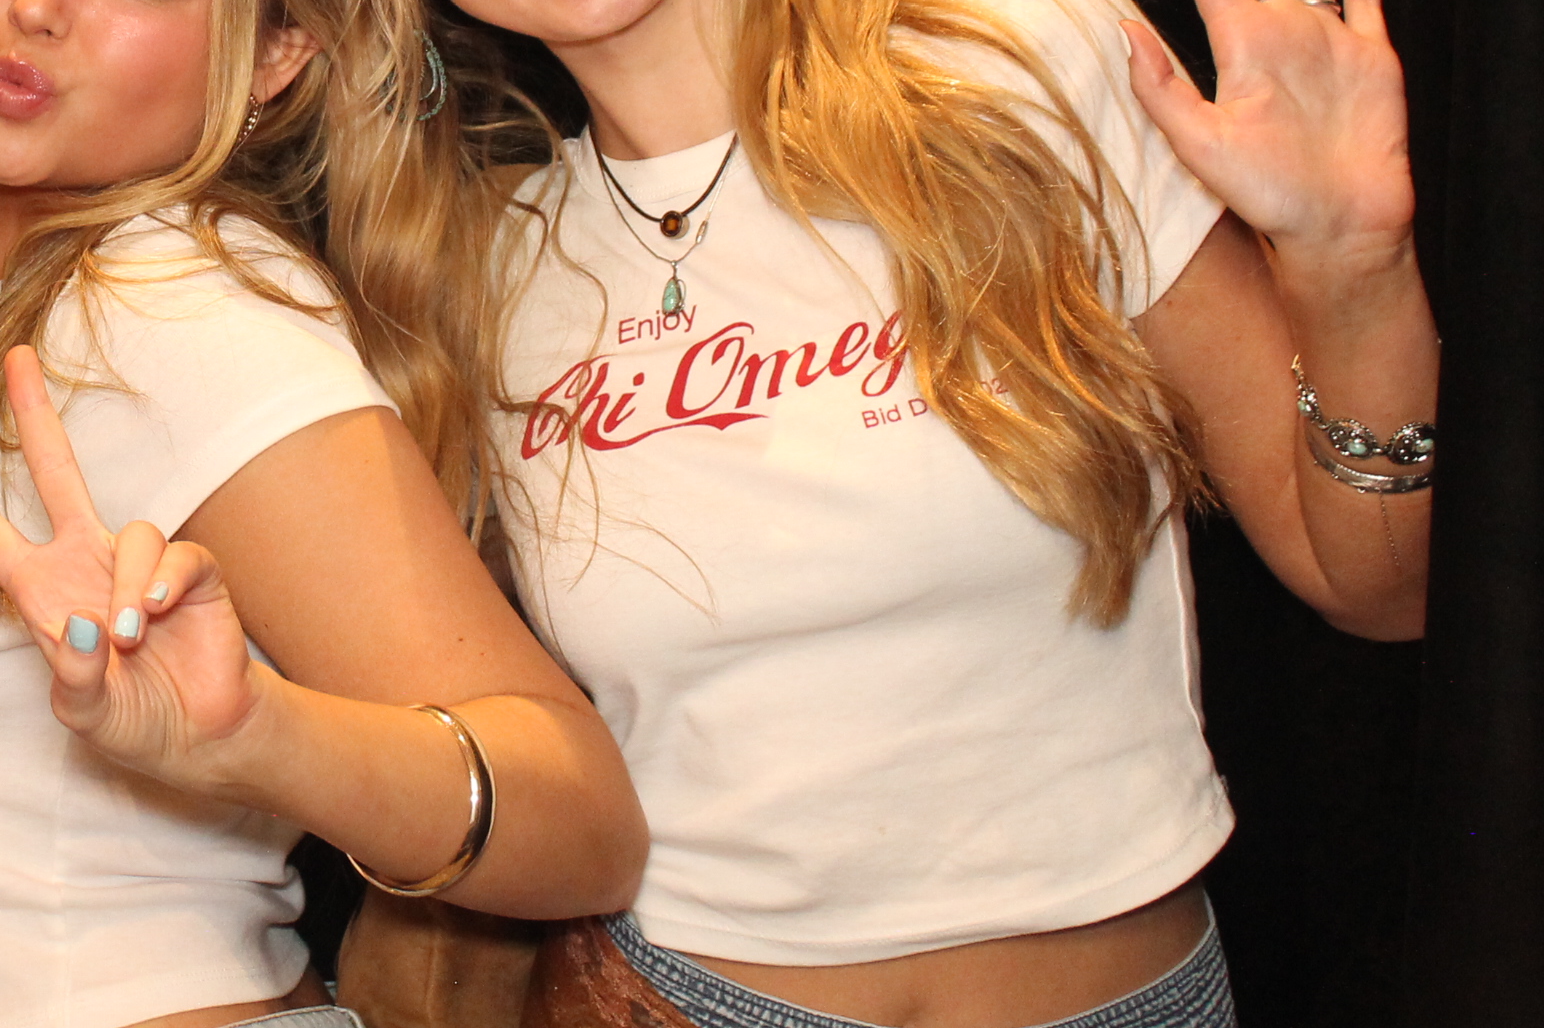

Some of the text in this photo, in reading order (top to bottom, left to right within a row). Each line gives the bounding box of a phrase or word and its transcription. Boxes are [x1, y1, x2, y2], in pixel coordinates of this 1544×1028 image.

[617, 305, 696, 343] Enjoy
[521, 309, 909, 460] Chi Omeg
[861, 404, 902, 428] Bid
